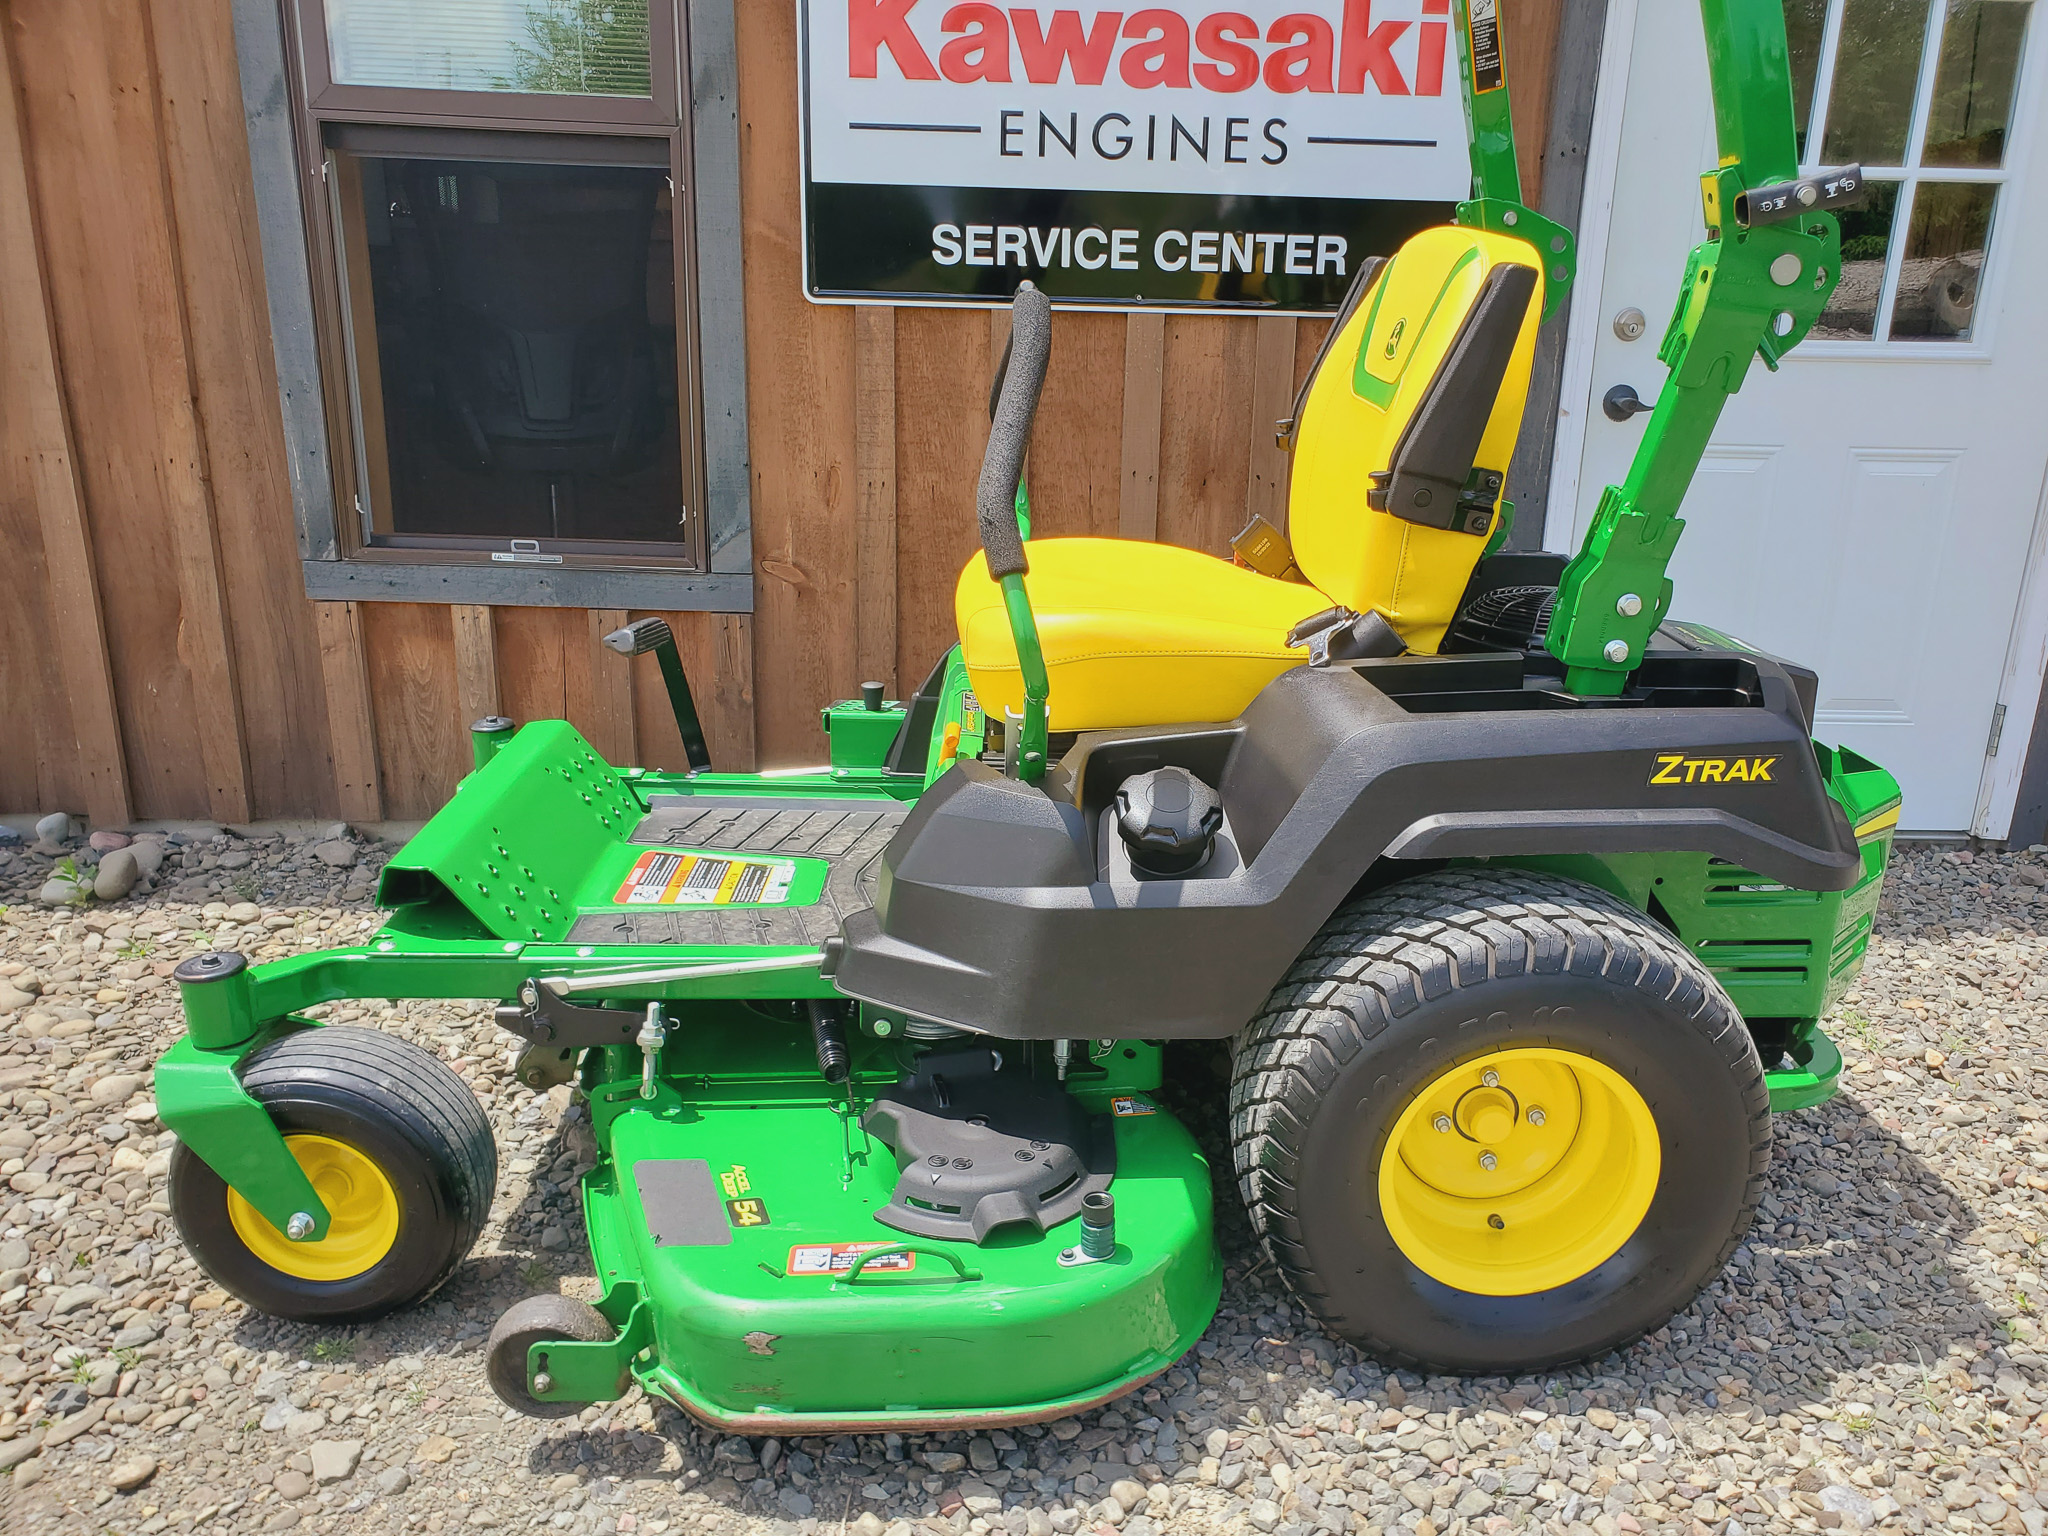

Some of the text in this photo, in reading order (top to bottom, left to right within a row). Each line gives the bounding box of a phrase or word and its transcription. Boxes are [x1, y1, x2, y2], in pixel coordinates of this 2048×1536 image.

[848, 0, 1448, 96] Kawasaki
[999, 110, 1290, 165] ENGINES
[931, 223, 1347, 276] SERVICE CENTER
[1650, 755, 1777, 784] ZTRAK
[720, 1172, 740, 1198] DEEP
[733, 1200, 762, 1226] 54
